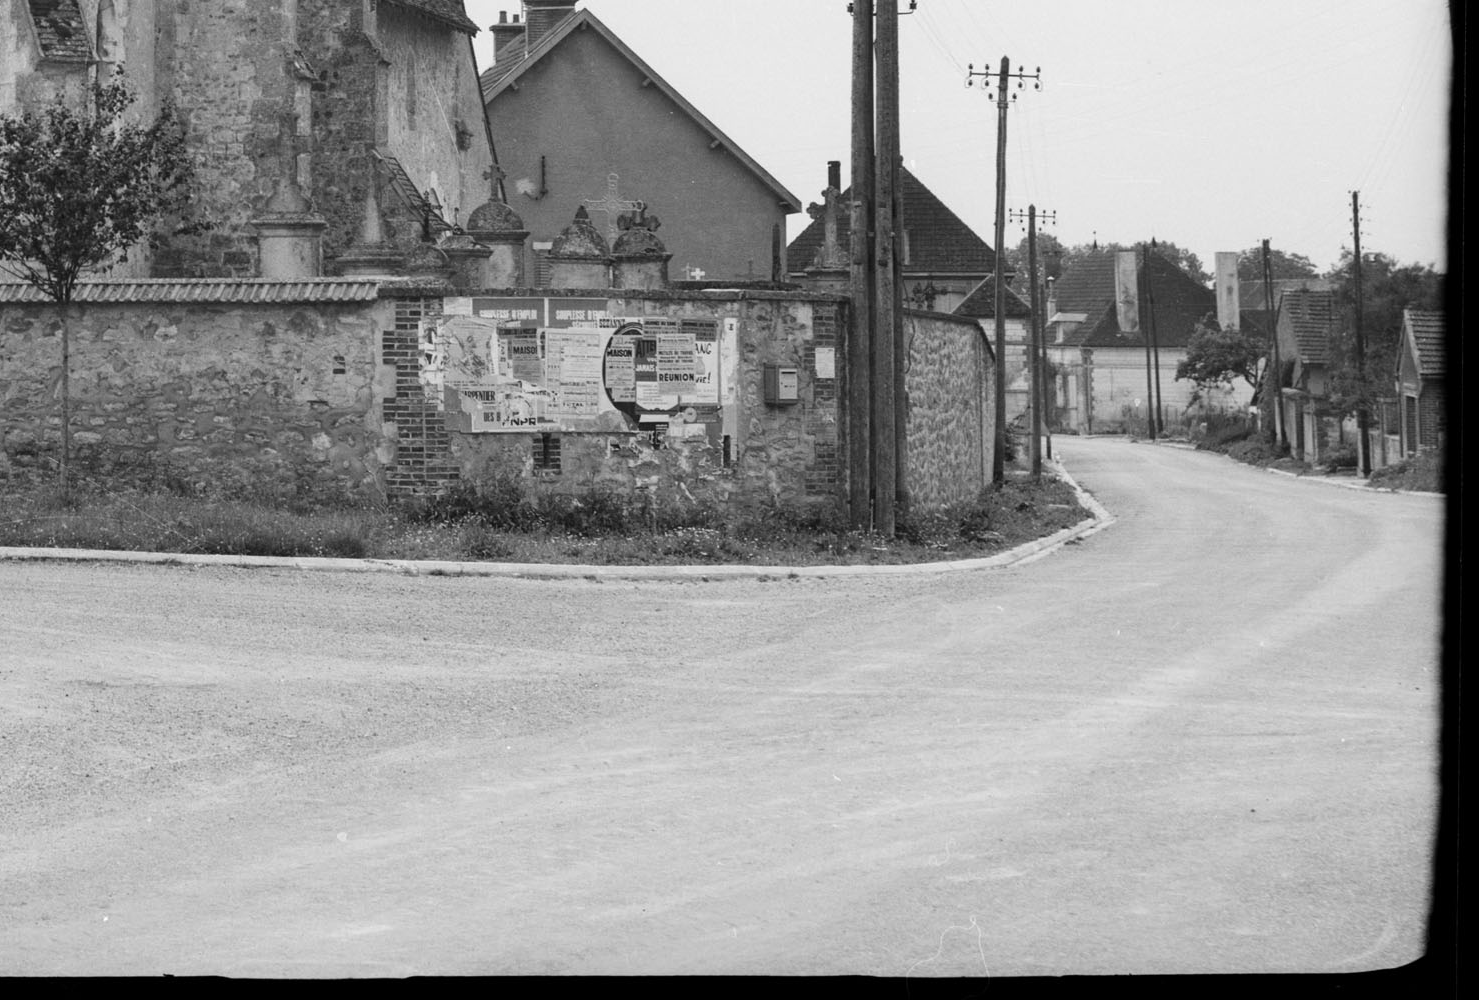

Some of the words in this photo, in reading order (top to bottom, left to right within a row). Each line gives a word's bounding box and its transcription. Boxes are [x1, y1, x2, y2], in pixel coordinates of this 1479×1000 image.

[555, 310, 586, 320] SOUPLESSE
[607, 349, 633, 358] MAISON
[658, 373, 695, 382] RÉUNION
